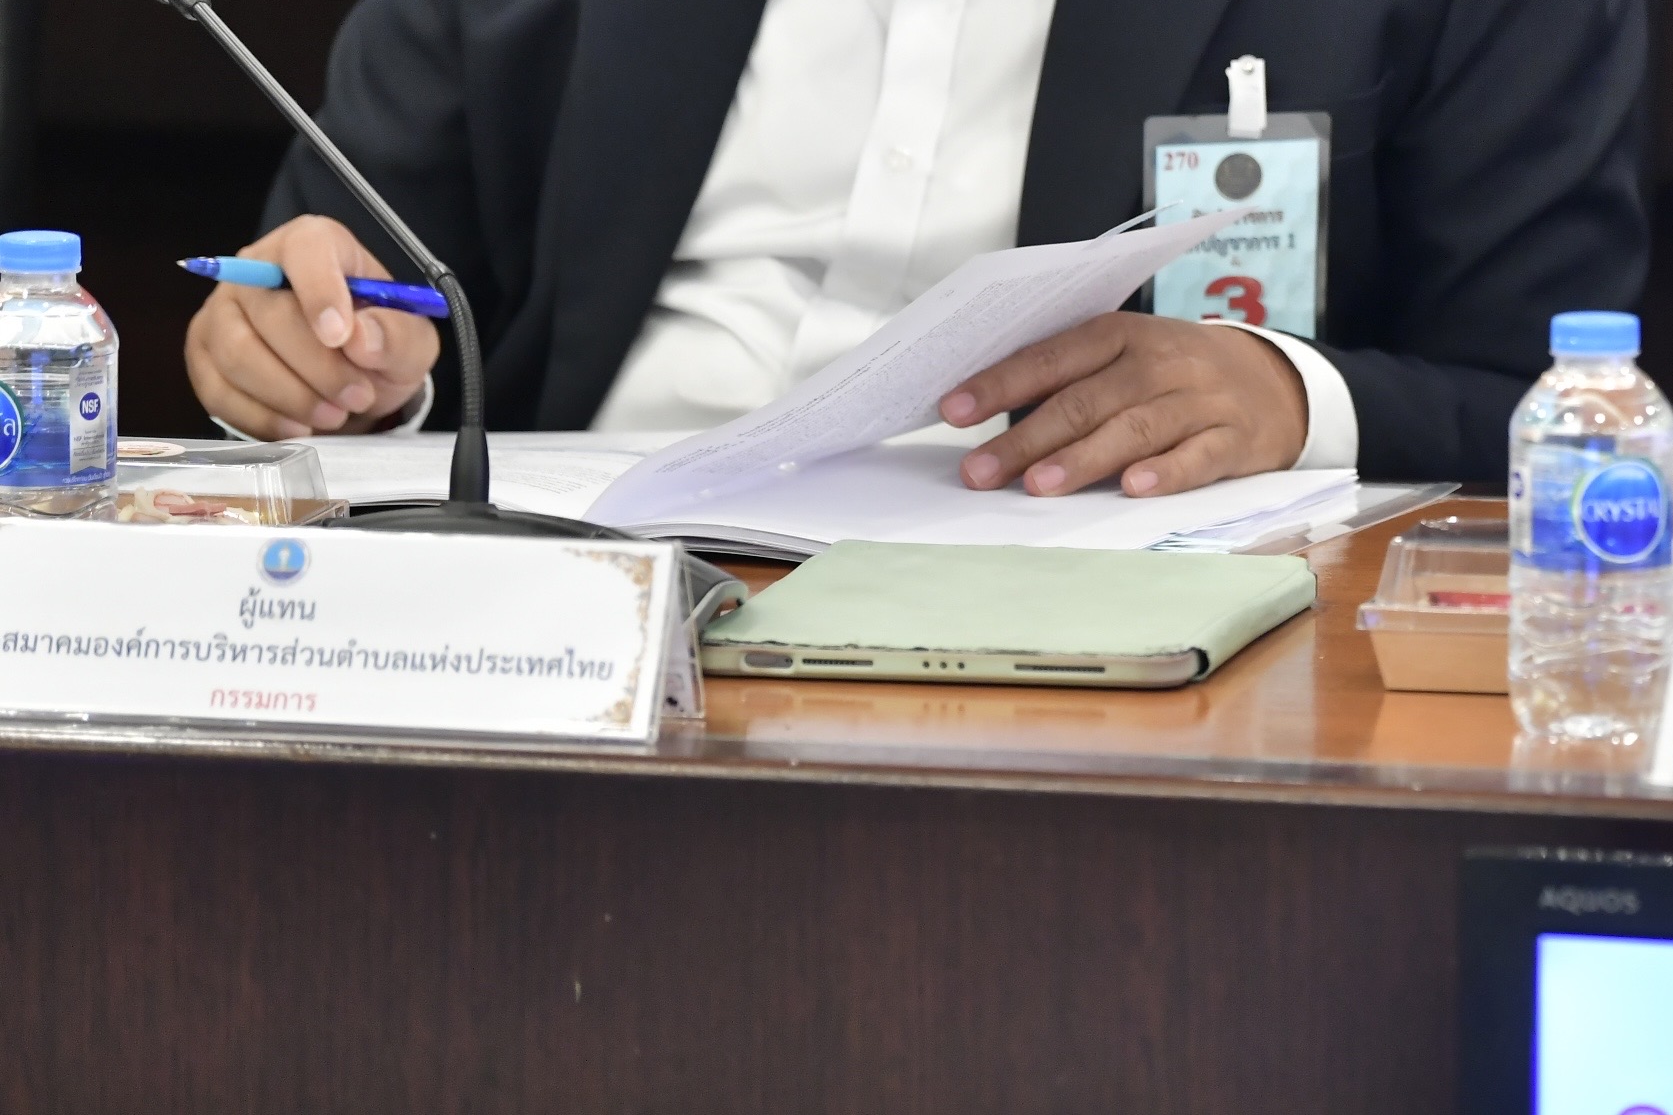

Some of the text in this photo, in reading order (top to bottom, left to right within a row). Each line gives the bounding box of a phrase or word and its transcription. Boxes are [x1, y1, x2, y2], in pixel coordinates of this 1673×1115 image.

[1165, 153, 1199, 171] 270
[1201, 276, 1267, 327] 3
[81, 398, 100, 415] NSF
[238, 587, 317, 629] ผู้แทน
[1, 626, 615, 681] สมาคมองค์การบริหารส่วนตำบลแห่งประเทศไทย
[209, 687, 318, 712] กรรมการ
